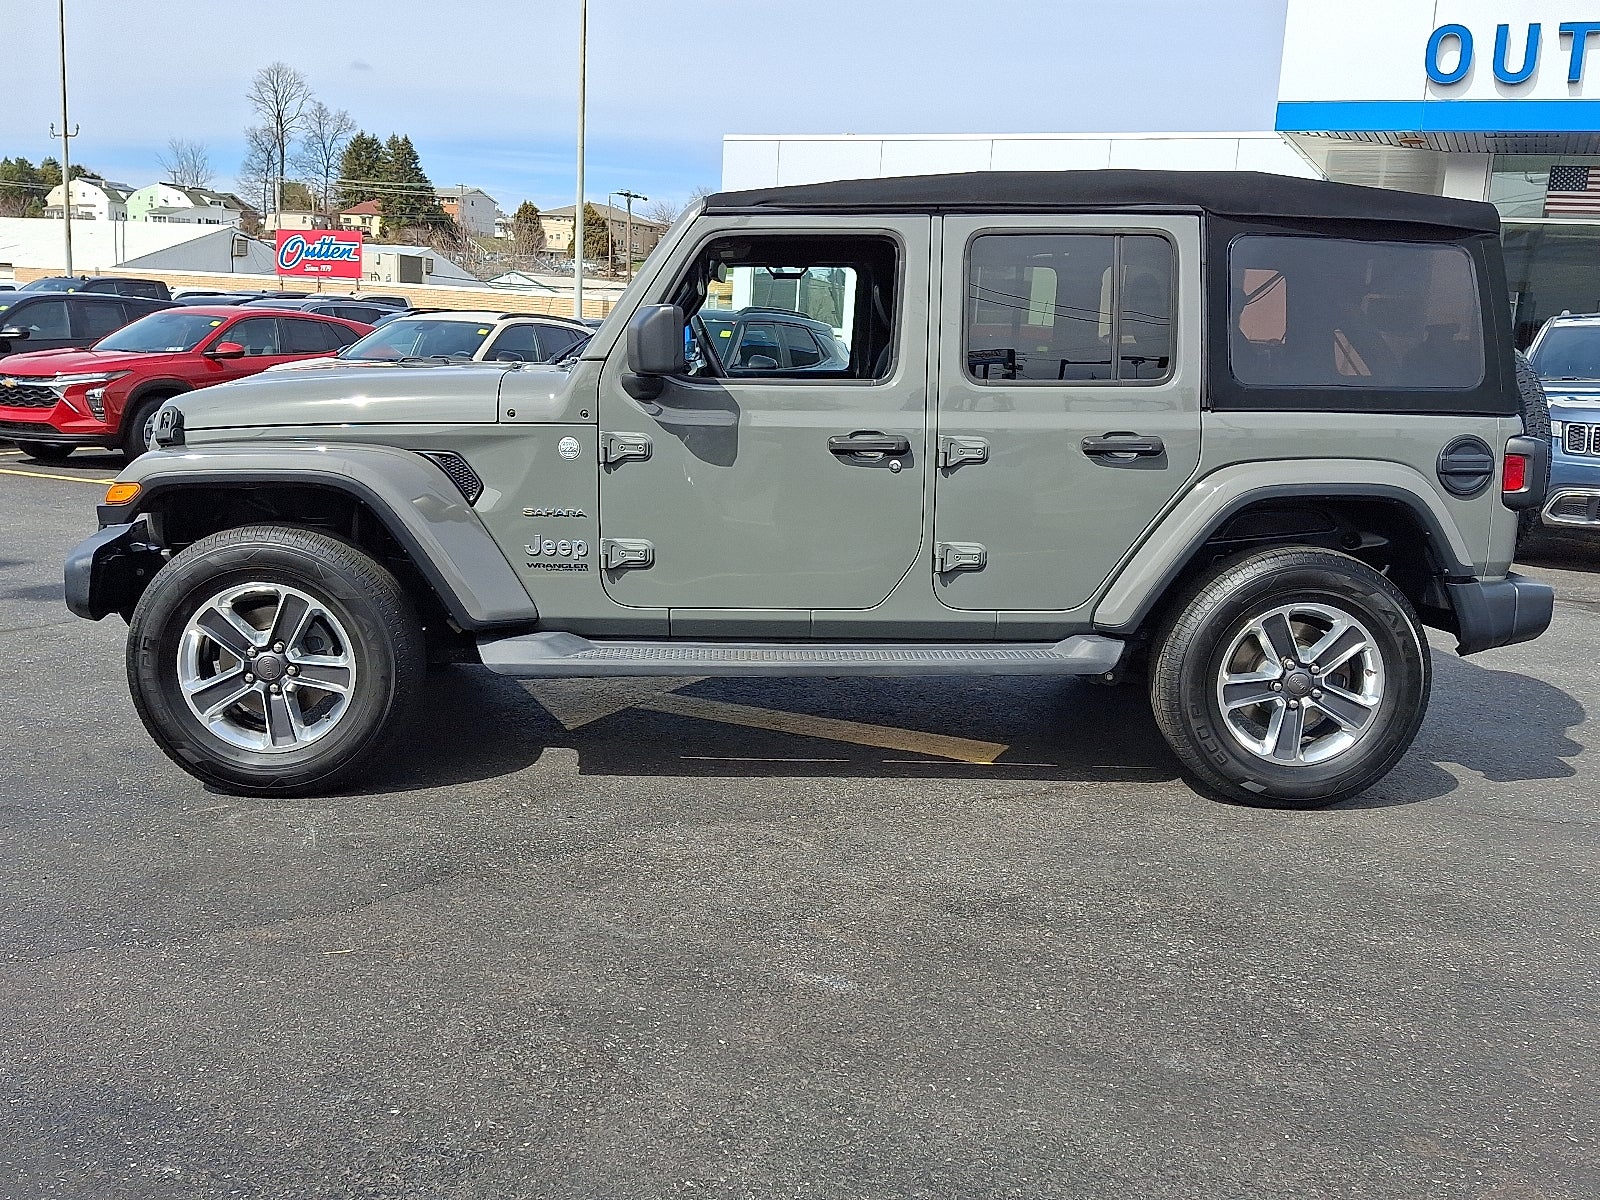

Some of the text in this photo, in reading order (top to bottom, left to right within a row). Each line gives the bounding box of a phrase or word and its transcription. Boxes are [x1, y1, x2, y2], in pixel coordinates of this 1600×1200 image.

[1425, 22, 1600, 84] OUT
[278, 234, 359, 270] Outten
[522, 507, 587, 518] SAHARA
[524, 534, 588, 560] Jeep
